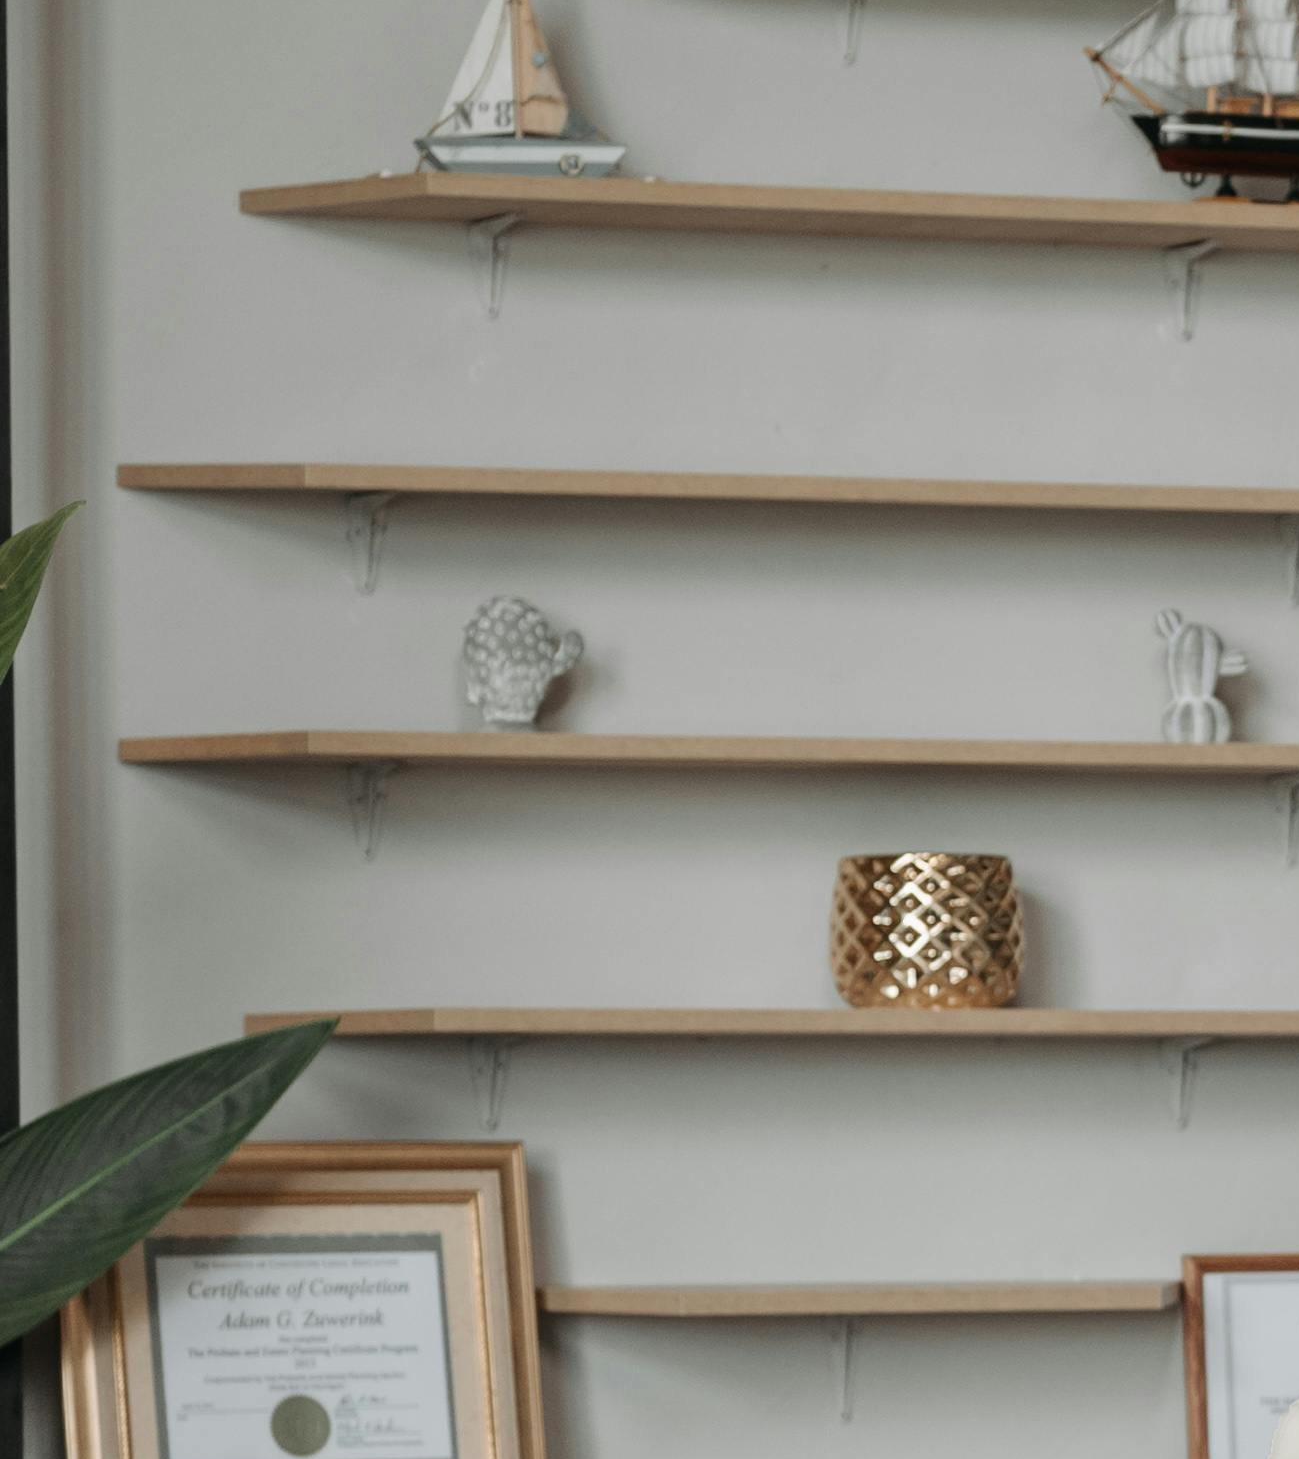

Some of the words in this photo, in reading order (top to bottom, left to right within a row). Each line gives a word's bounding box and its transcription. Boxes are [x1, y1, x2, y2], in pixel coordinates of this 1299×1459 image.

[187, 1278, 281, 1301] Certificate
[286, 1276, 306, 1301] of
[309, 1276, 410, 1300] Completion
[220, 1310, 271, 1330] Adam
